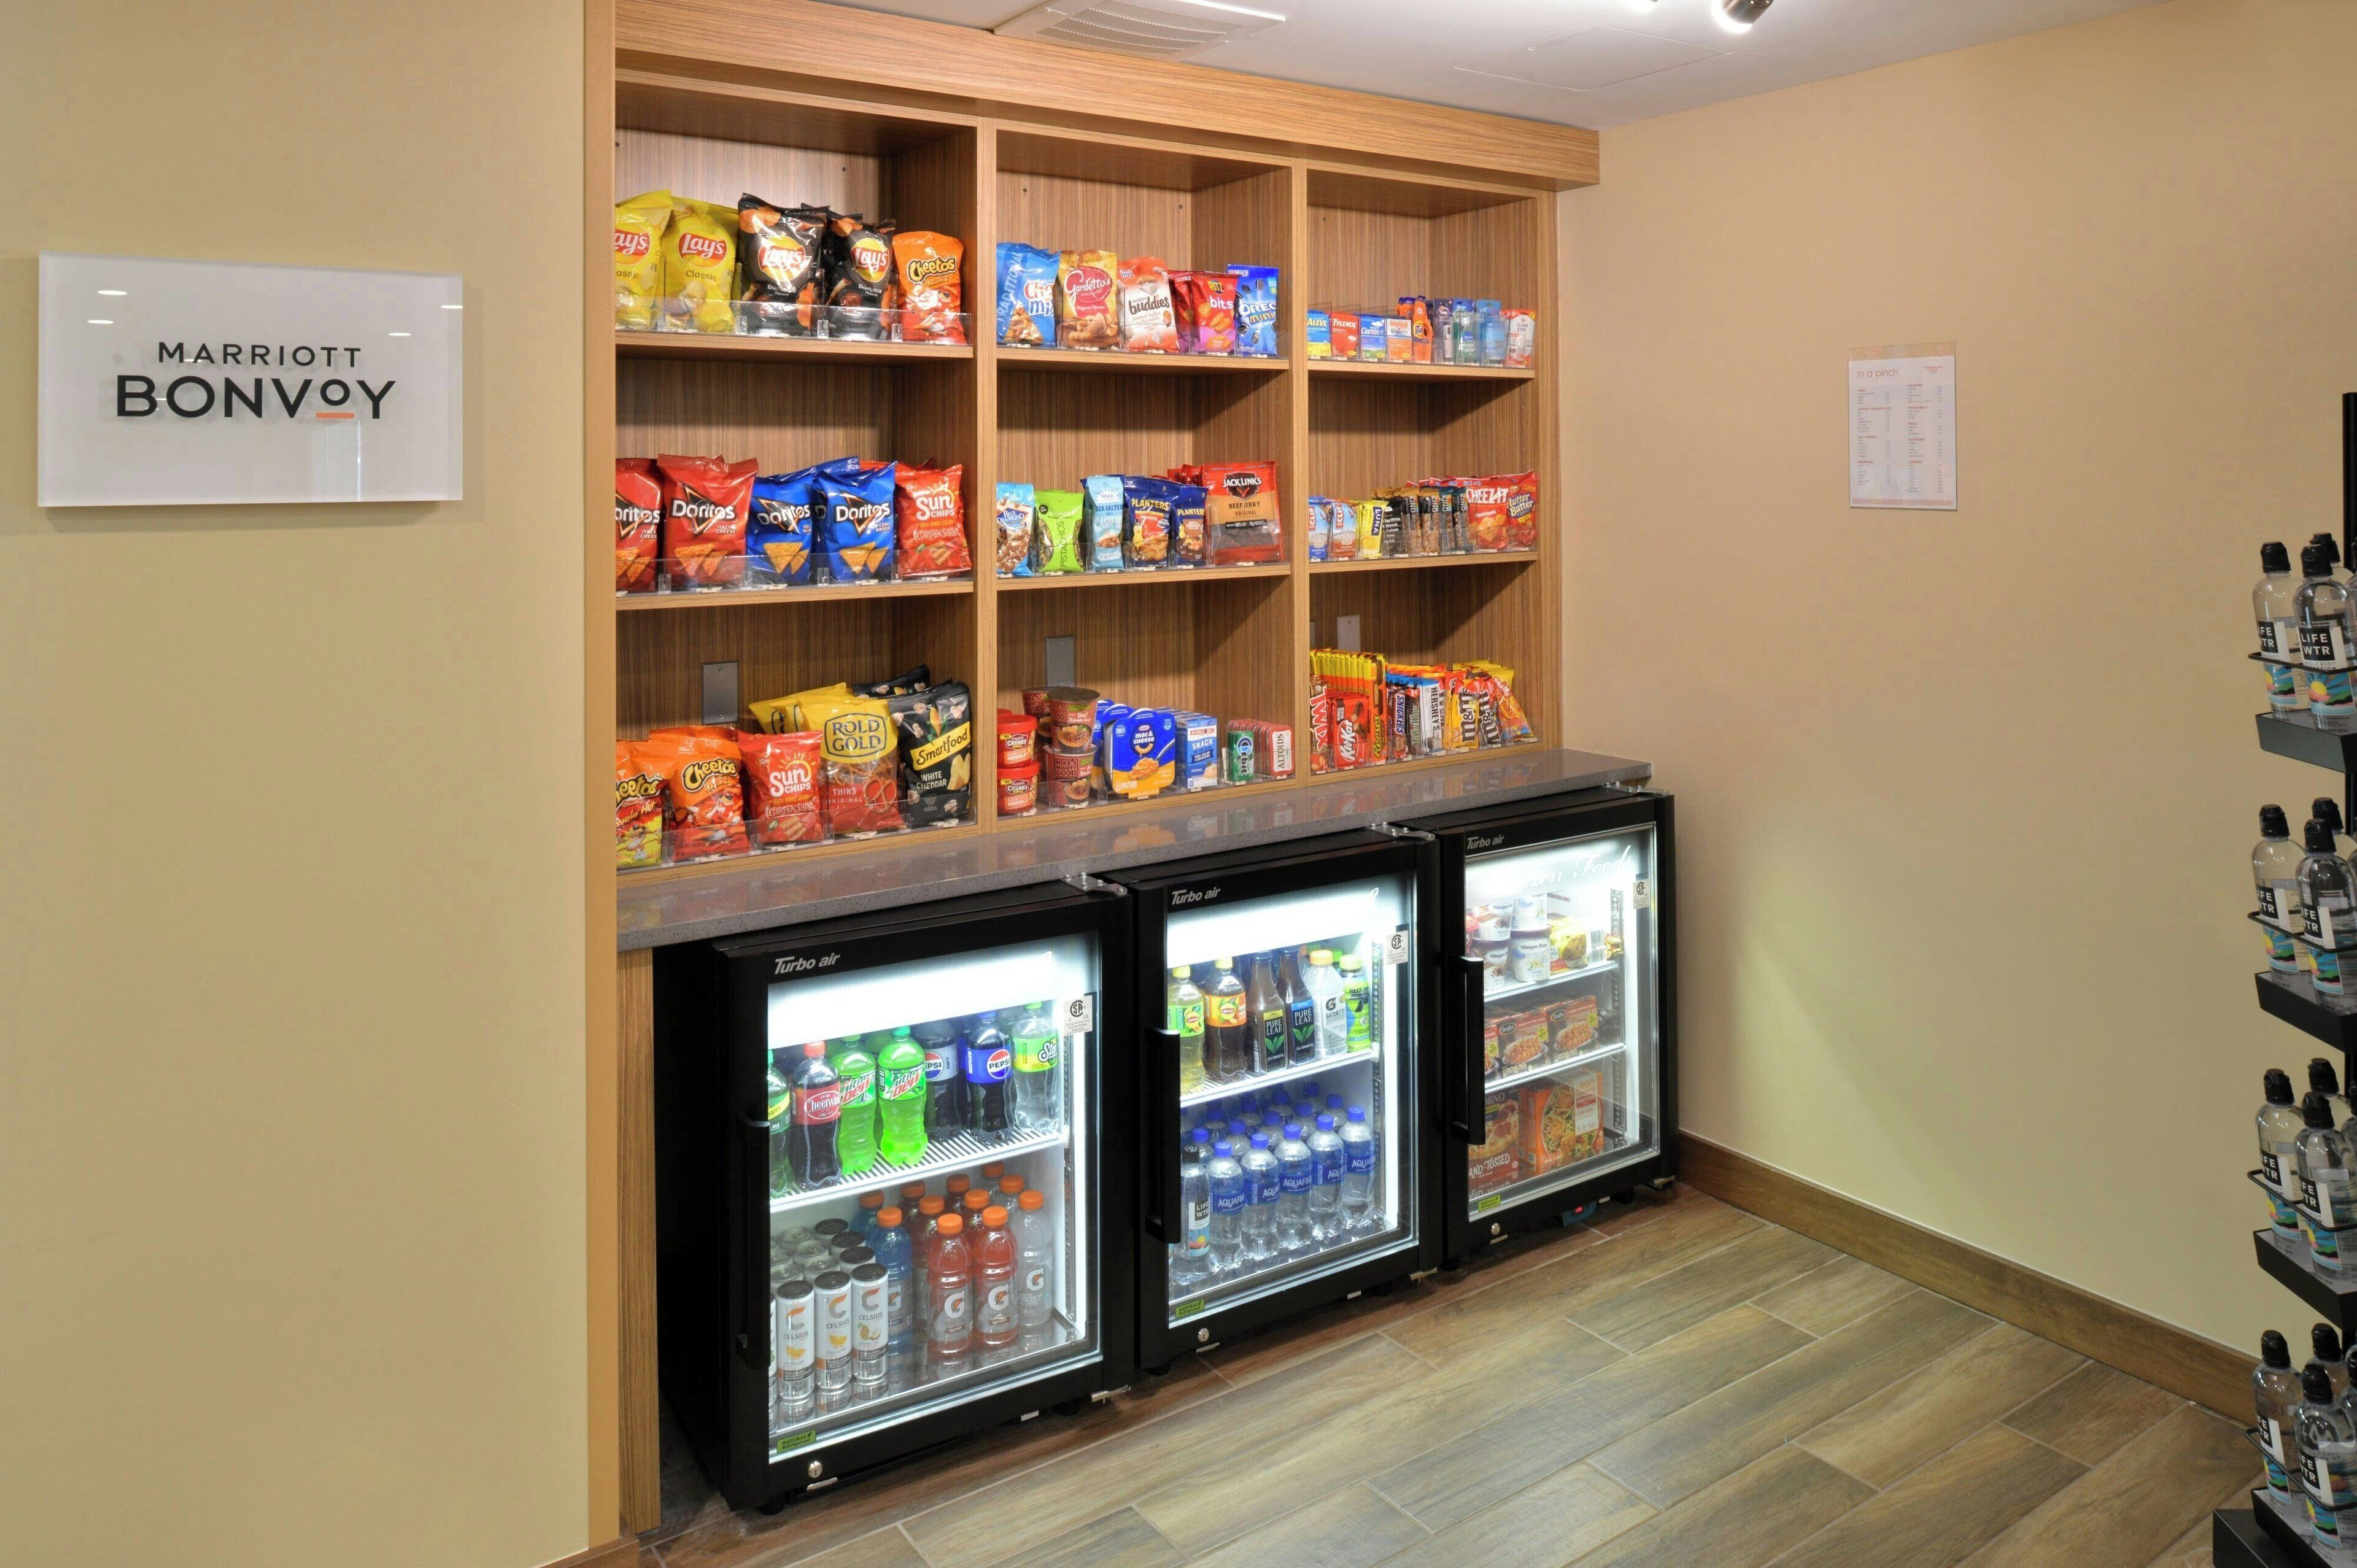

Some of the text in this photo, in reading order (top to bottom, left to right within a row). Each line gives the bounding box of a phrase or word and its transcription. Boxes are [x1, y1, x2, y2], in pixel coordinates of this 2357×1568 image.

[681, 234, 725, 258] Lay's
[854, 247, 888, 272] Lay's
[616, 270, 639, 279] assic
[686, 270, 717, 281] Classic
[908, 257, 957, 282] Cheetos
[1024, 280, 1055, 301] Che
[1064, 269, 1110, 311] Gardetto's
[1208, 280, 1224, 293] RITZ
[1129, 296, 1170, 315] buddies
[1210, 295, 1233, 310] bits
[1307, 317, 1327, 327] ALEVE
[1333, 319, 1357, 328] TYLENOL
[1361, 326, 1379, 335] Claritin
[158, 341, 362, 368] MARRIOTT
[1857, 369, 1865, 378] In
[1875, 368, 1898, 379] pinch
[117, 374, 396, 419] BONVOY
[1222, 478, 1240, 488] JACK
[672, 500, 735, 520] Doritos
[836, 502, 890, 522] Doritos
[916, 493, 954, 521] Sun
[1131, 498, 1170, 511] PLANTERS
[1510, 501, 1533, 516] Butter
[615, 506, 661, 523] oritos
[757, 504, 810, 525] Doritos
[931, 509, 955, 518] CHIPS
[997, 512, 1024, 523] DIAMOND
[1056, 521, 1067, 567] PISTACHIOS
[2261, 638, 2274, 647] TR
[2301, 633, 2328, 643] LIFE
[2303, 646, 2330, 655] WTR
[1396, 695, 1406, 735] SNICKERS
[832, 719, 880, 736] ROLD
[832, 736, 881, 752] GOLD
[1192, 738, 1213, 750] SNACK
[1372, 716, 1381, 758] Reese's
[916, 731, 968, 765] Smartfood
[683, 759, 737, 790] Cheetos
[921, 771, 942, 782] WHITE
[770, 768, 811, 797] Sun
[784, 782, 811, 794] CHIPS
[916, 779, 947, 790] CHEDDAR
[832, 787, 857, 796] THINS
[1466, 835, 1504, 850] Turbo air
[1171, 887, 1221, 906] Turbo air
[2302, 910, 2316, 920] IFE
[774, 952, 840, 975] Turbo air
[1295, 1008, 1312, 1018] PURE
[1266, 1019, 1282, 1029] PURE
[1295, 1016, 1313, 1026] LEAF
[1266, 1025, 1283, 1036] LEAF
[989, 1058, 1010, 1069] PEPSI
[804, 1097, 840, 1114] Cheerwin
[1469, 1153, 1511, 1179] AND-TOSSED
[1197, 1201, 1209, 1210] LIFE
[1218, 1192, 1245, 1208] AQUAFIN
[2304, 1193, 2316, 1207] TR
[944, 1291, 965, 1318] G
[989, 1284, 1009, 1311] G
[826, 1318, 850, 1329] CELSIUS
[859, 1311, 883, 1321] CELSIUS
[783, 1330, 809, 1340] CELSIUS
[782, 1434, 808, 1445] NATURAL
[2302, 1467, 2316, 1483] TR
